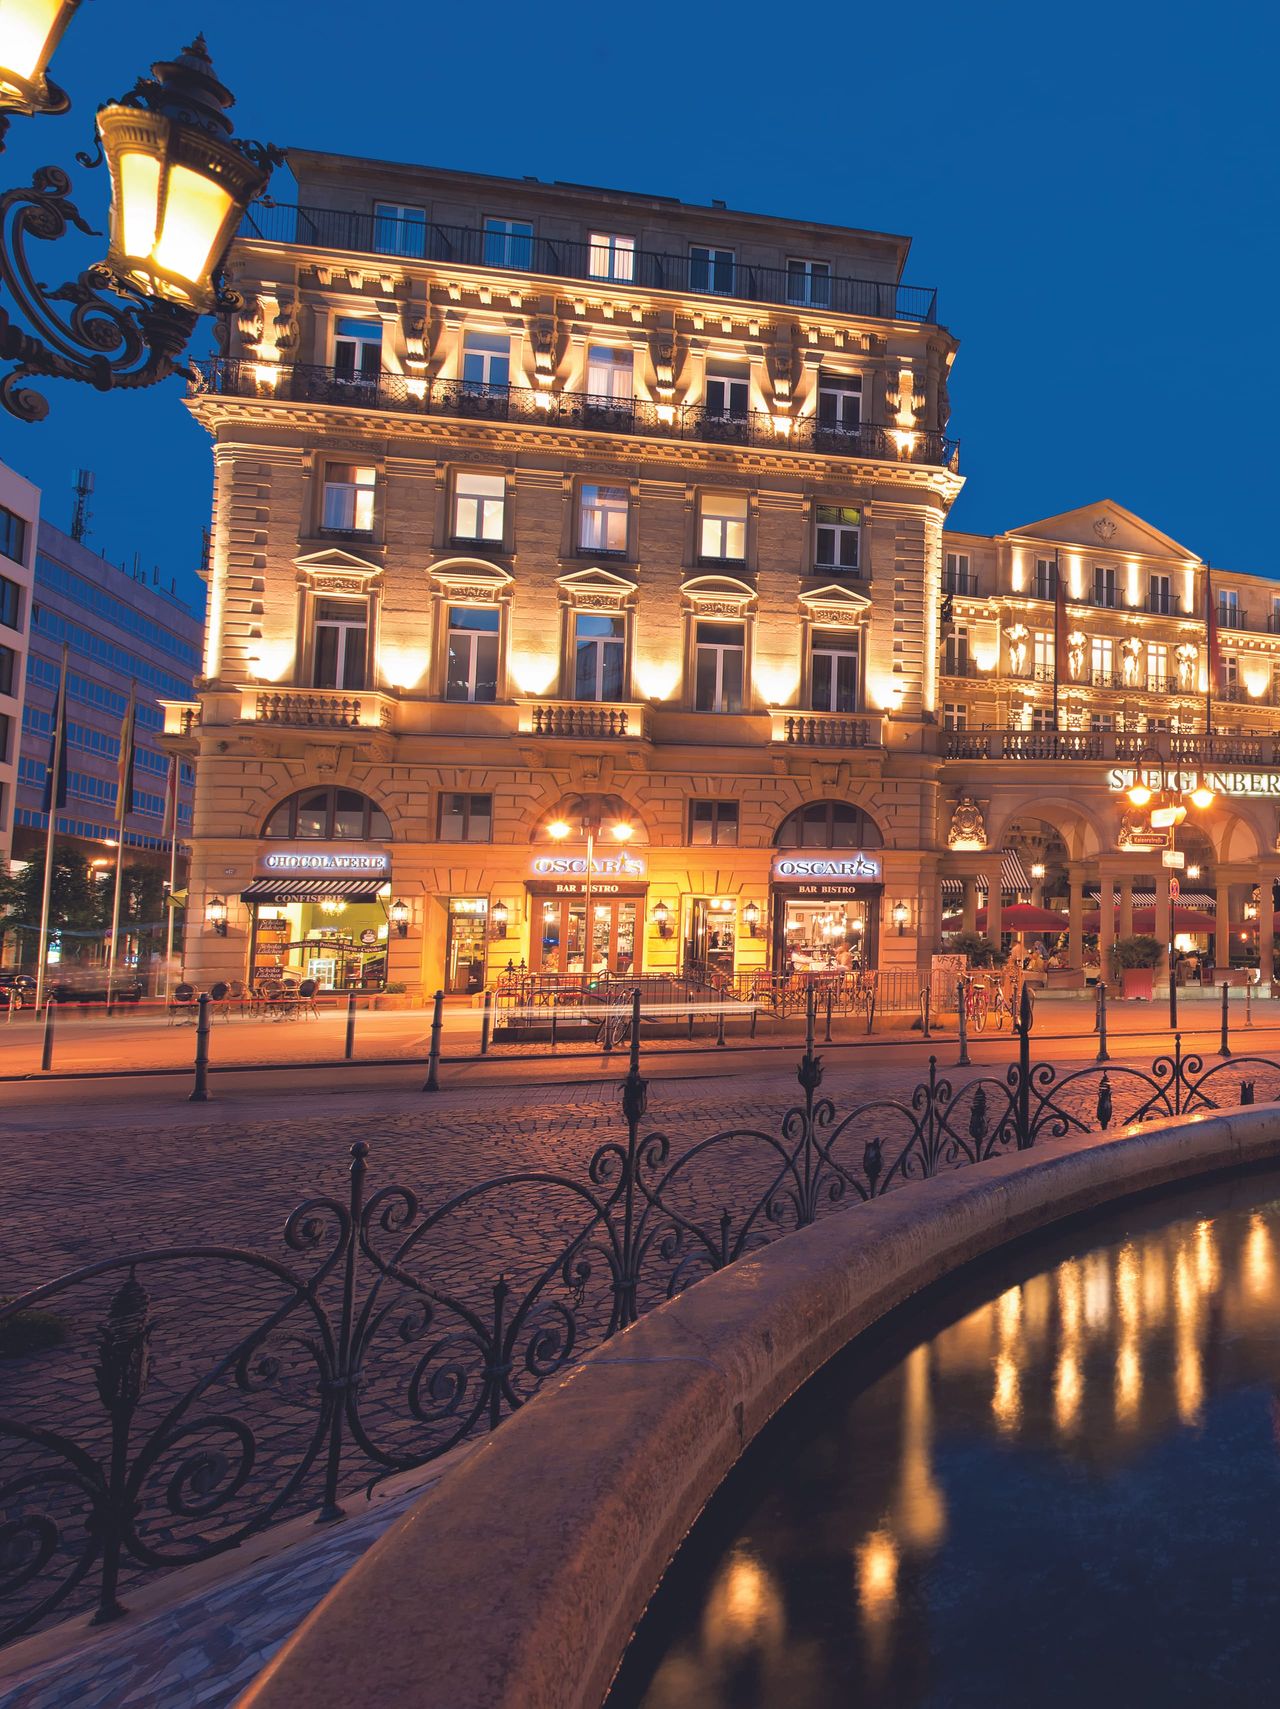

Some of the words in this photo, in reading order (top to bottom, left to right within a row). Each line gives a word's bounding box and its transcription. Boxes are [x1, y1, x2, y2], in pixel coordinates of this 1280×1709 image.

[266, 855, 384, 869] CHOCOLATERIE
[556, 884, 577, 892] BAR
[581, 884, 619, 893] BSTRO
[799, 885, 818, 893] BAR
[821, 886, 856, 894] BISTRO
[274, 894, 345, 903] CONFISERIE
